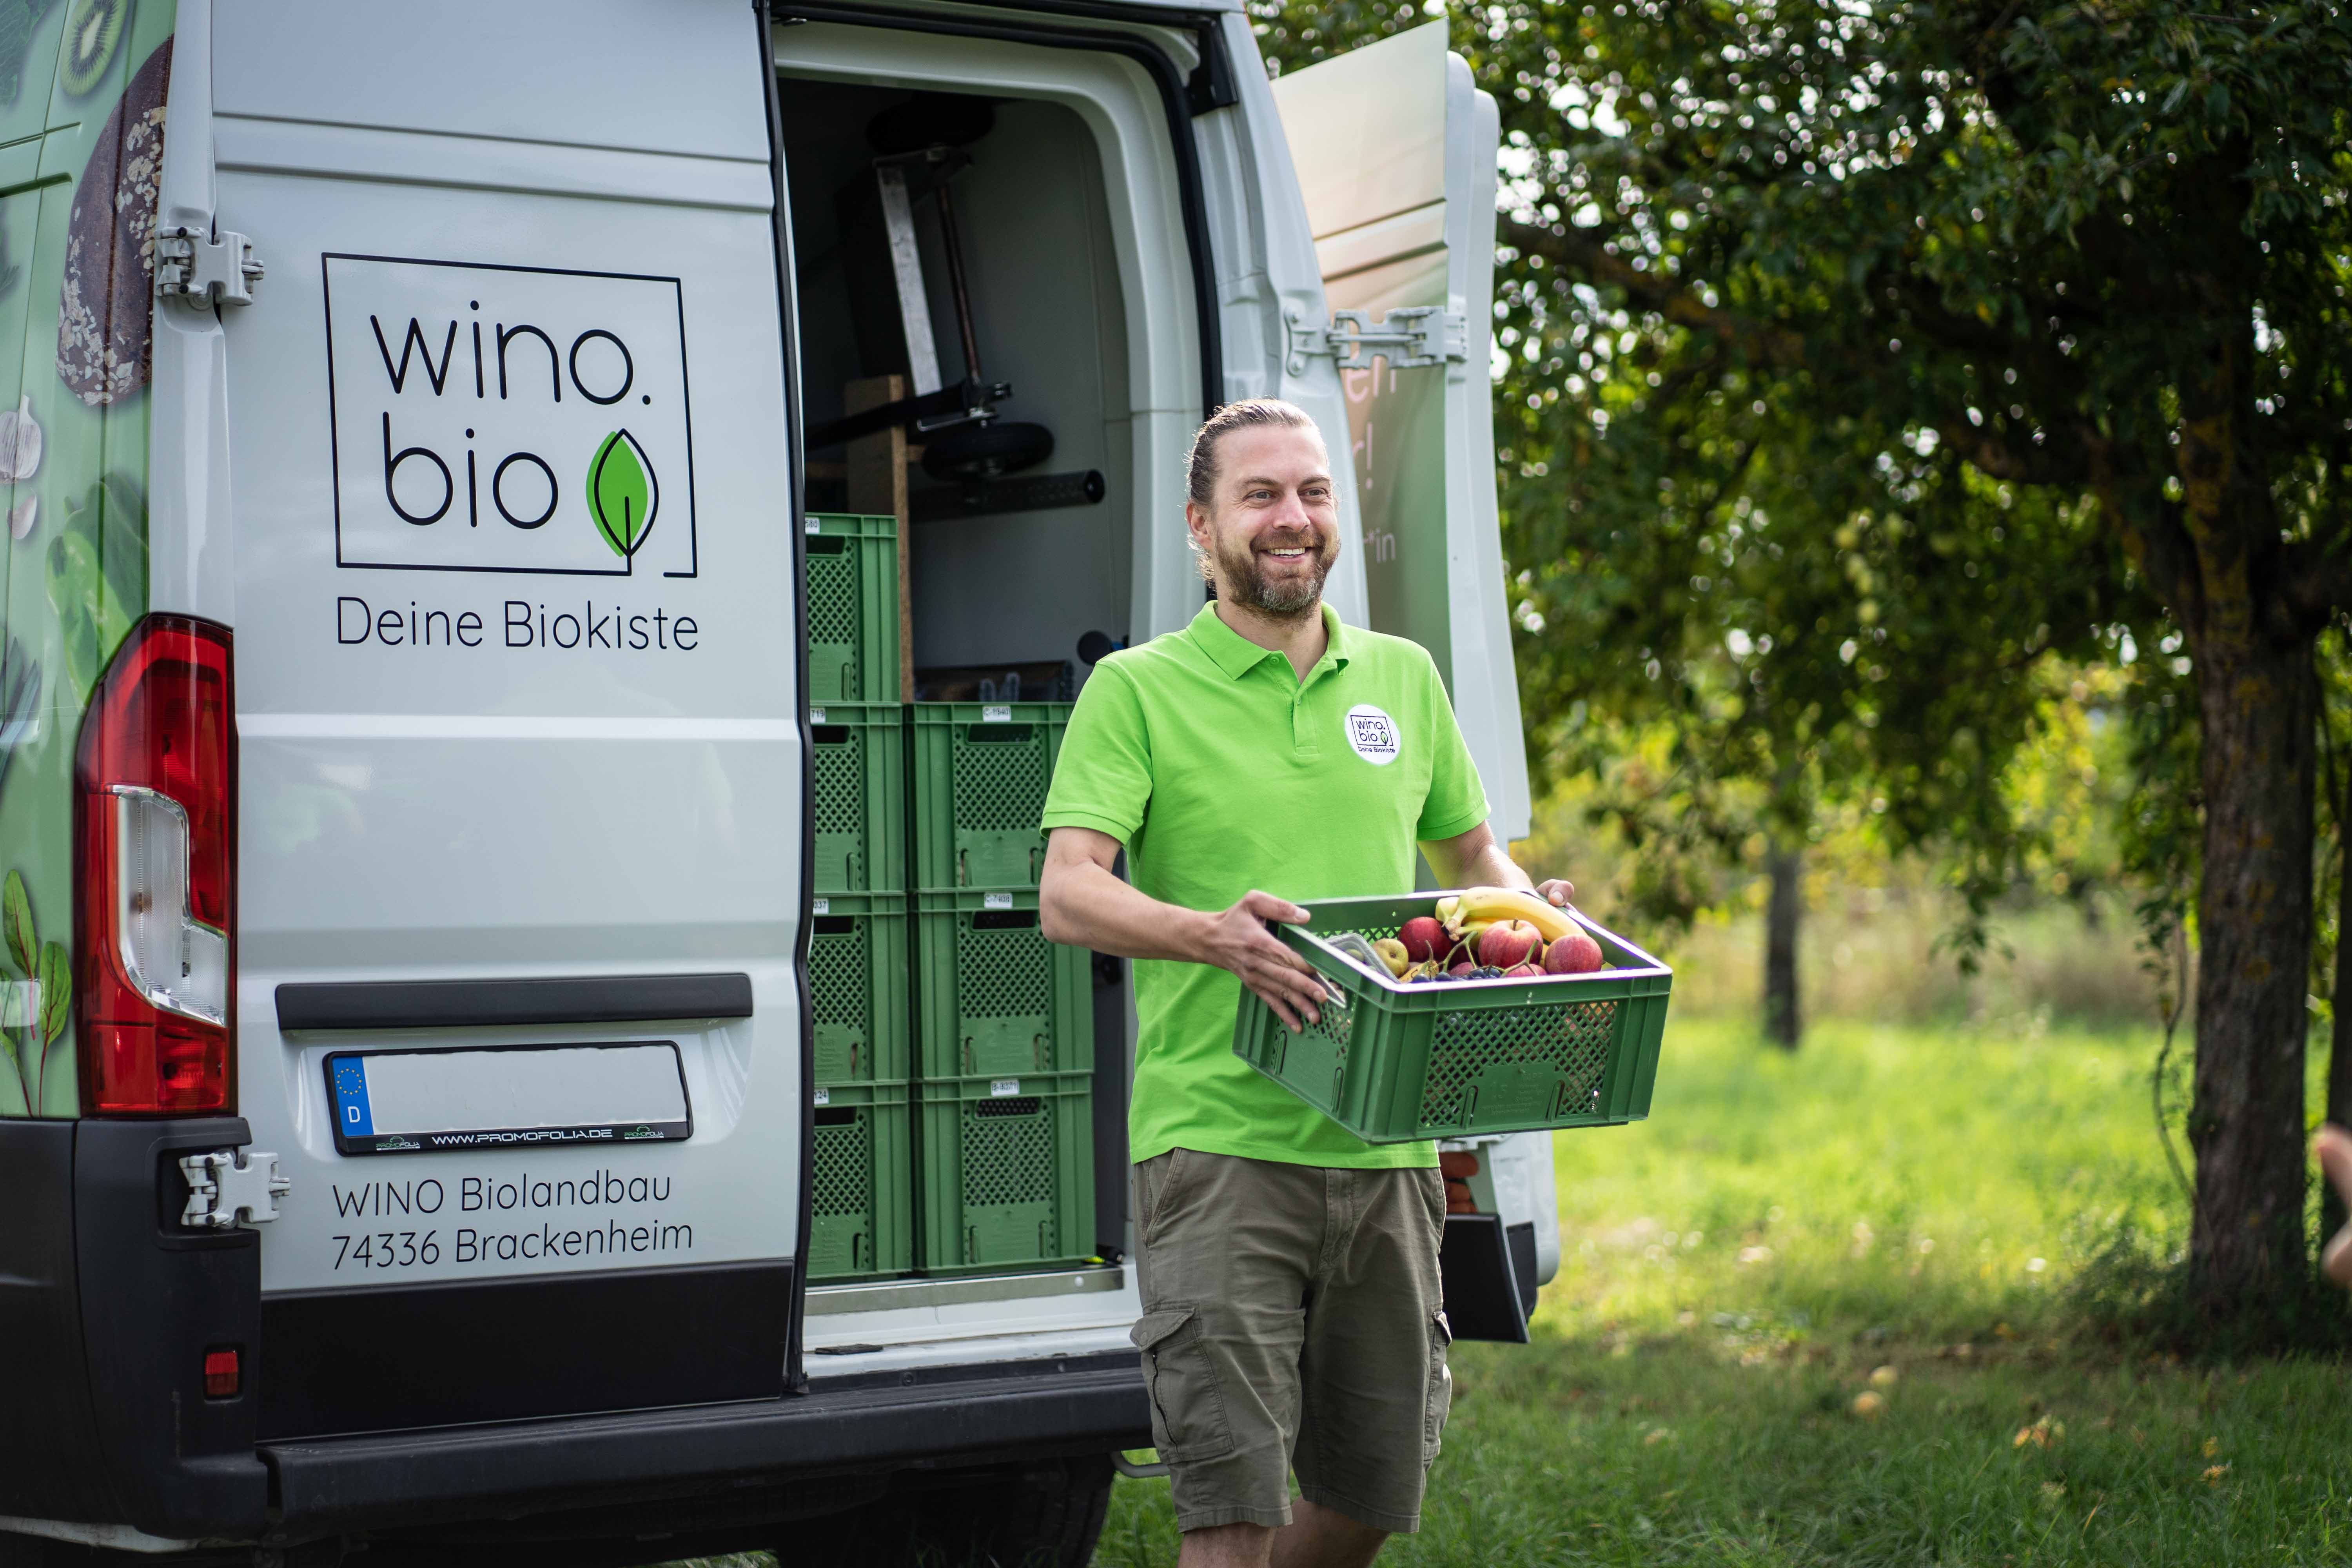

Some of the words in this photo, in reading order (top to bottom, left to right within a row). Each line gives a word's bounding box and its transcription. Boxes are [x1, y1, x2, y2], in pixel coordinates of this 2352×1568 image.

[370, 301, 650, 405] wino.
[383, 412, 558, 529] bio
[338, 597, 482, 646] Deine
[505, 601, 697, 650] Biokiste
[1356, 718, 1385, 730] wino.
[1358, 730, 1378, 742] bio
[348, 1106, 360, 1122] D
[431, 1129, 613, 1145] WWW.PROMOFOLIA.DE
[333, 1180, 443, 1218] WINO
[462, 1169, 670, 1211] Biolandbau
[332, 1230, 439, 1270] 74336
[456, 1219, 692, 1263] Brackenheim
